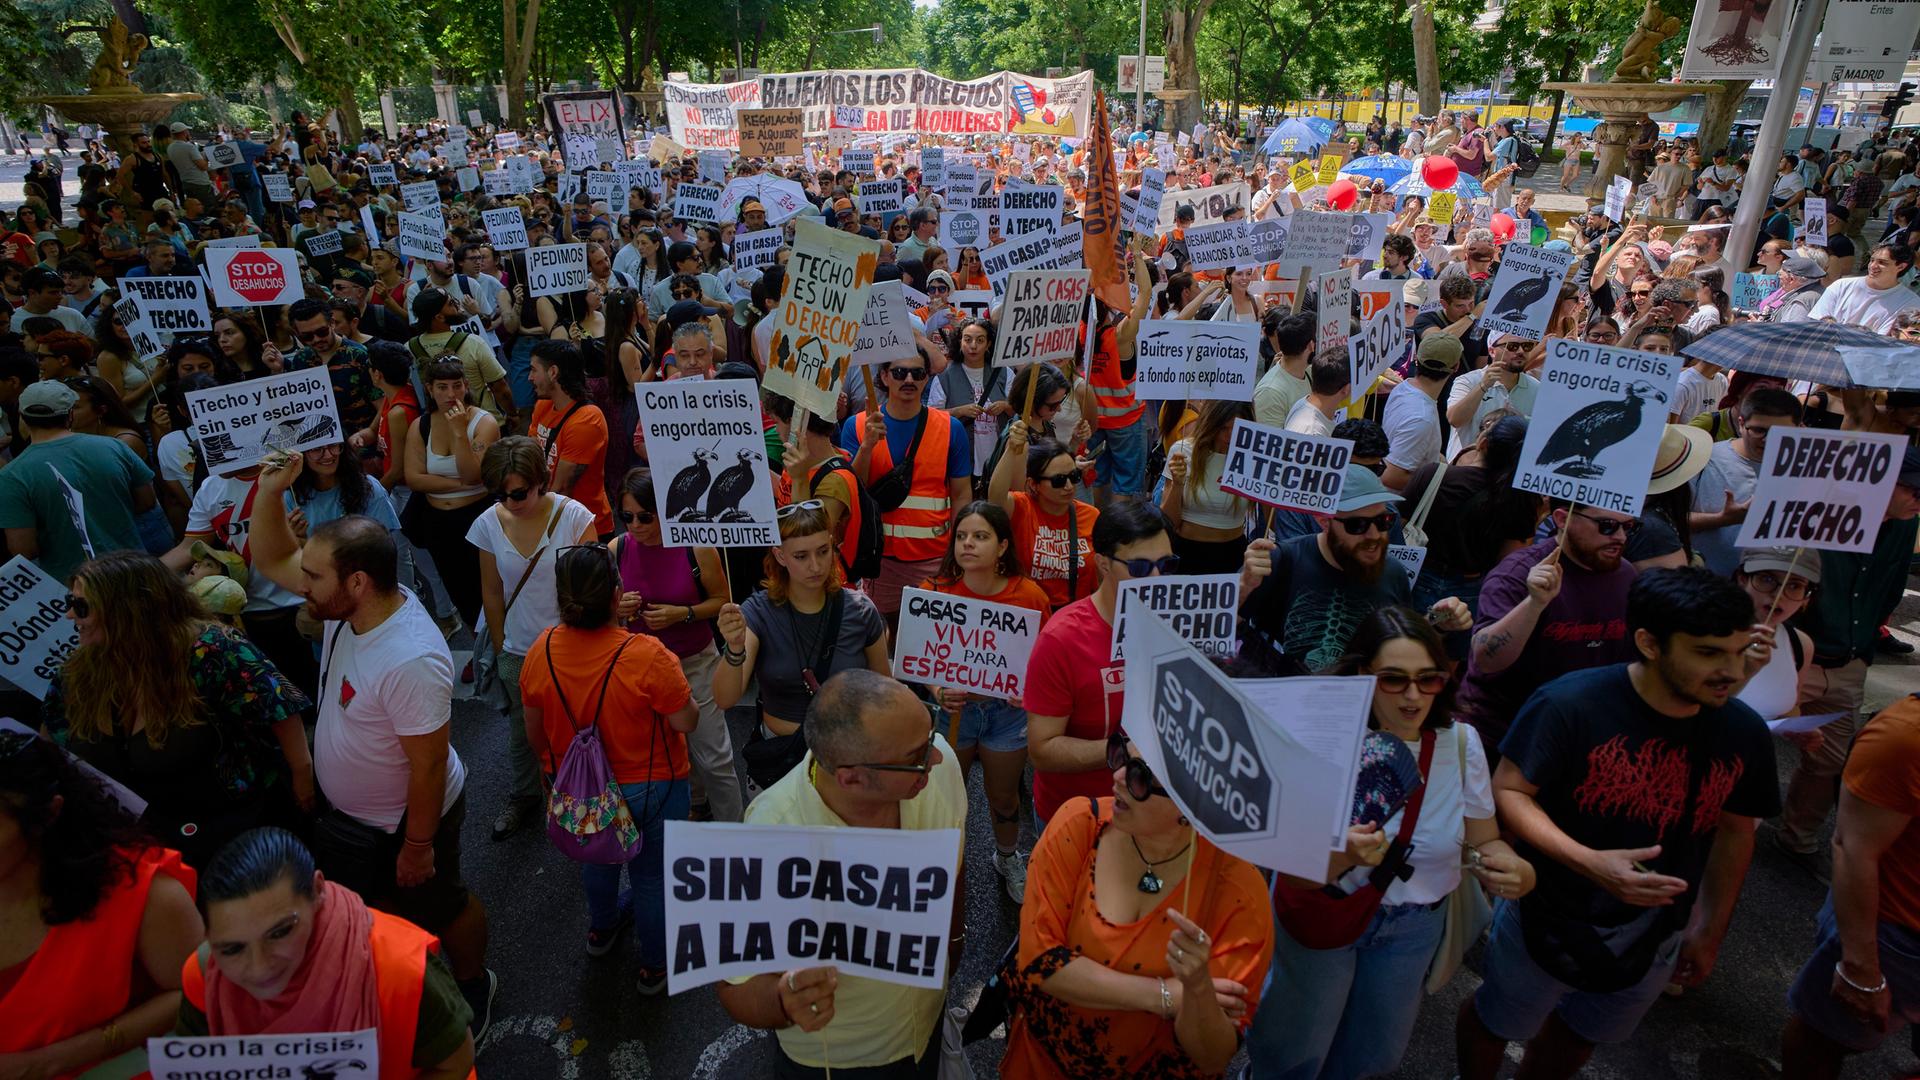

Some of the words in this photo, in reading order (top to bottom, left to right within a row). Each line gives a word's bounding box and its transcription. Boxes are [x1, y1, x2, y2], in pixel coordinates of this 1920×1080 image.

[1870, 5, 1894, 15] Entes
[1843, 69, 1885, 80] MADRID
[726, 83, 761, 103] VIVIR
[762, 74, 860, 108] BAJEMOS
[863, 73, 906, 107] LOS
[909, 74, 1004, 108] PRECIOS
[561, 101, 610, 123] ELIX
[702, 107, 734, 125] PARA
[808, 110, 827, 132] LA
[891, 110, 912, 131] DE
[914, 110, 1003, 133] ALQUILERES
[741, 129, 755, 139] DE
[757, 128, 798, 139] ALQUILER
[759, 141, 785, 154] YA!!!
[854, 154, 874, 162] CASA?
[370, 166, 392, 174] DERECHO
[588, 186, 596, 196] LO
[680, 184, 719, 202] DERECHO
[862, 182, 898, 196] DERECHO
[866, 202, 872, 212] A
[872, 199, 900, 212] TECHO.
[1004, 192, 1057, 210] DERECHO
[678, 204, 684, 216] A
[686, 204, 716, 220] TECHO.
[952, 220, 978, 230] STOP
[1006, 218, 1014, 235] A
[1350, 224, 1370, 234] OP
[308, 232, 340, 246] DERECHO
[736, 241, 751, 254] SIN
[752, 236, 782, 250] CASA?
[1185, 229, 1236, 248] DESAHUCIAR,
[1249, 229, 1284, 245] STOP
[530, 247, 584, 272] ¡PEDIMOS
[737, 258, 742, 270] A
[744, 256, 753, 268] LA
[755, 252, 774, 264] CALL
[984, 254, 1009, 276] SIN
[1008, 238, 1051, 266] CASA?
[1192, 255, 1196, 265] A
[1197, 249, 1228, 264] BANCOS
[1230, 246, 1235, 258] &
[1510, 242, 1528, 256] Con
[1530, 248, 1539, 258] la
[1540, 250, 1568, 268] crisis,
[231, 263, 278, 276] STOP
[796, 251, 854, 289] TECHO
[1504, 258, 1542, 276] engorda
[124, 280, 197, 300] DERECHO
[232, 278, 284, 290] DESAHUCIOS
[531, 274, 547, 290] LO
[551, 269, 586, 288] JUSTO!
[1014, 278, 1042, 302] LAS
[1046, 277, 1086, 302] CASAS
[1324, 280, 1336, 295] NO
[1339, 276, 1350, 290] NOS
[794, 279, 816, 304] ES
[823, 287, 847, 313] UN
[149, 309, 206, 330] TECHO.
[786, 302, 859, 347] DERECHO
[1013, 305, 1050, 332] PARA
[1322, 320, 1338, 338] NOS
[1483, 318, 1512, 334] BANCO
[1002, 334, 1032, 360] LAS
[1140, 339, 1184, 358] Buitres
[1186, 344, 1193, 362] y
[1196, 341, 1249, 364] gaviotas,
[1555, 340, 1590, 362] Con
[1594, 347, 1611, 366] la
[1614, 349, 1672, 381] crisis,
[1138, 373, 1145, 383] a
[1146, 366, 1176, 384] fondo
[1178, 372, 1196, 384] nos
[1198, 369, 1246, 388] explotan.
[1548, 367, 1621, 395] engorda
[190, 392, 251, 420] ¡Techo
[251, 393, 262, 410] y
[266, 376, 326, 404] trabajo,
[645, 391, 680, 410] Con
[684, 390, 698, 410] la
[702, 390, 754, 412] crisis,
[198, 418, 226, 436] sin
[231, 412, 258, 429] ser
[262, 394, 330, 422] esclavo!
[650, 418, 758, 442] engordamos.
[1235, 426, 1350, 470] DERECHO
[1772, 436, 1892, 485] DERECHO
[1228, 450, 1245, 475] A
[1252, 455, 1342, 496] TECHO
[1224, 474, 1234, 485] A
[1238, 477, 1280, 500] JUSTO
[1282, 489, 1337, 510] PRECIO!
[1520, 472, 1573, 502] BANCO
[1575, 484, 1636, 515] BUITRE.
[1754, 500, 1776, 540] A
[1776, 501, 1866, 546] TECHO.
[670, 526, 718, 545] BANCO
[722, 527, 776, 546] BUITRE.
[1031, 566, 1044, 580] DE
[908, 596, 968, 626] CASAS
[980, 608, 1028, 637] PARA
[0, 598, 62, 666] ¿Dónde
[934, 622, 996, 652] VIVIR
[924, 639, 952, 661] NO
[964, 648, 1008, 669] PARA
[1114, 646, 1124, 660] A
[902, 655, 1020, 696] ESPECULAR
[1163, 670, 1260, 780] STOP
[1156, 703, 1262, 832] DESAHUCIOS
[672, 856, 763, 902] SIN
[776, 856, 949, 914] CASA?
[673, 923, 707, 976] A
[718, 921, 776, 965] LA
[786, 918, 941, 978] CALLE!
[164, 1040, 227, 1060] Con
[238, 1040, 264, 1056] la
[274, 1038, 364, 1056] crisis,
[166, 1064, 292, 1080] engorda
